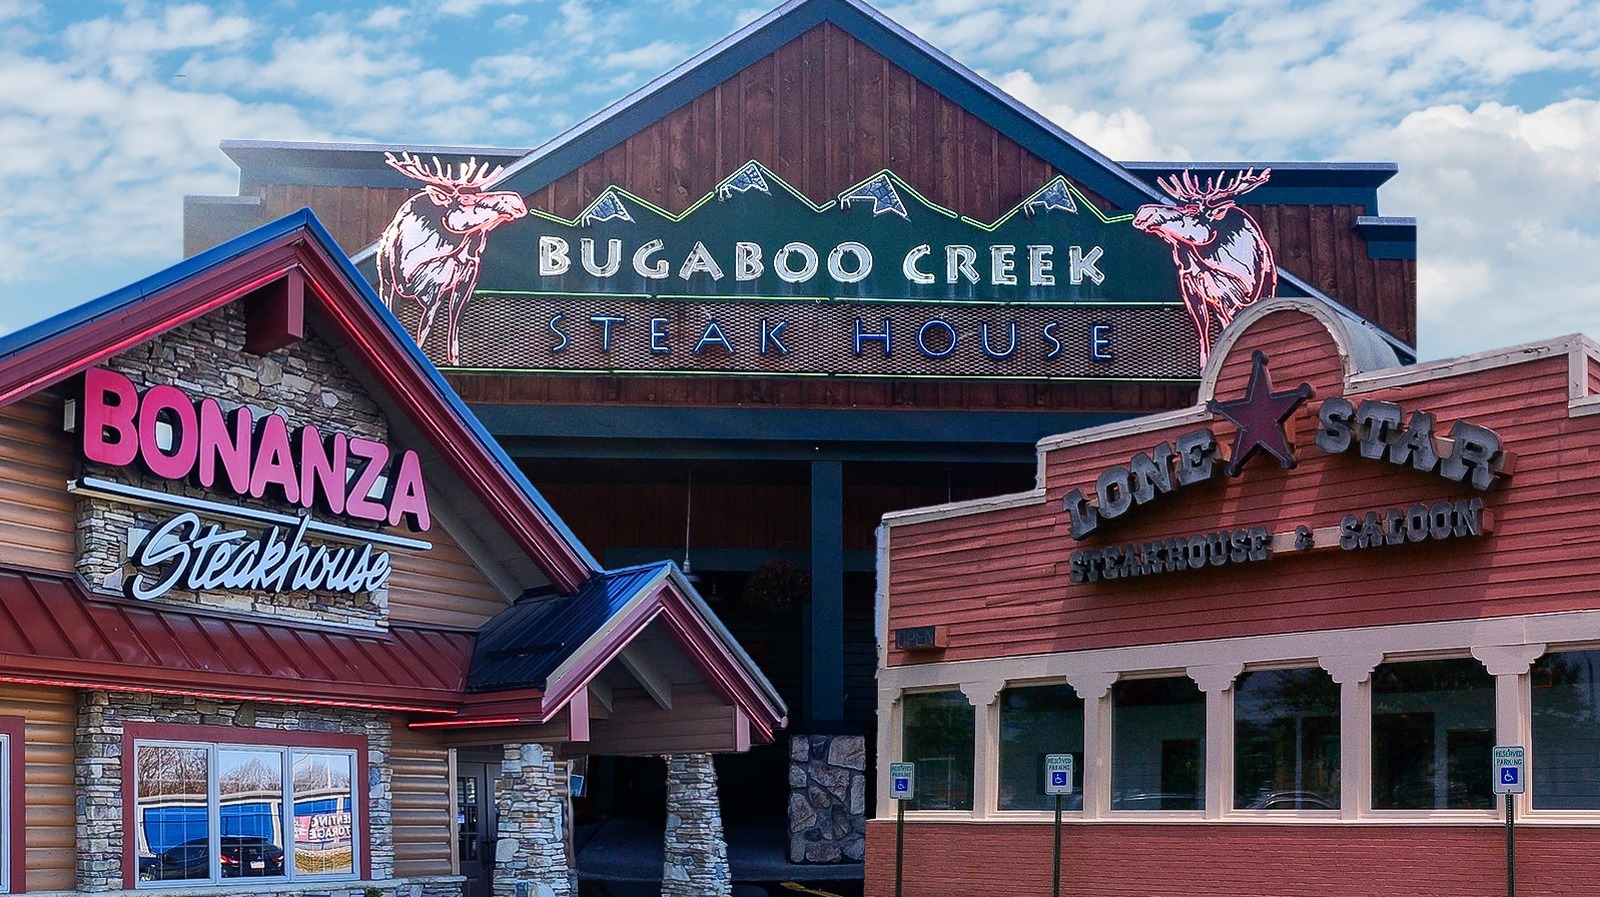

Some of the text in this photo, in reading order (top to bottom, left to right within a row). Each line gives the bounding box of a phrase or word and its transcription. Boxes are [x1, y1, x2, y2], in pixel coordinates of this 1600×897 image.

[538, 235, 1105, 286] BUGABOO CREEK
[547, 313, 1113, 362] STEAK HOUSE
[82, 367, 432, 532] BONANZA
[1062, 397, 1506, 541] LONE STAR
[130, 511, 392, 601] Steakhouse
[1069, 497, 1488, 583] STEAKHOUSE & SALOON
[896, 627, 934, 649] OPEN
[1495, 750, 1523, 758] RESERVED
